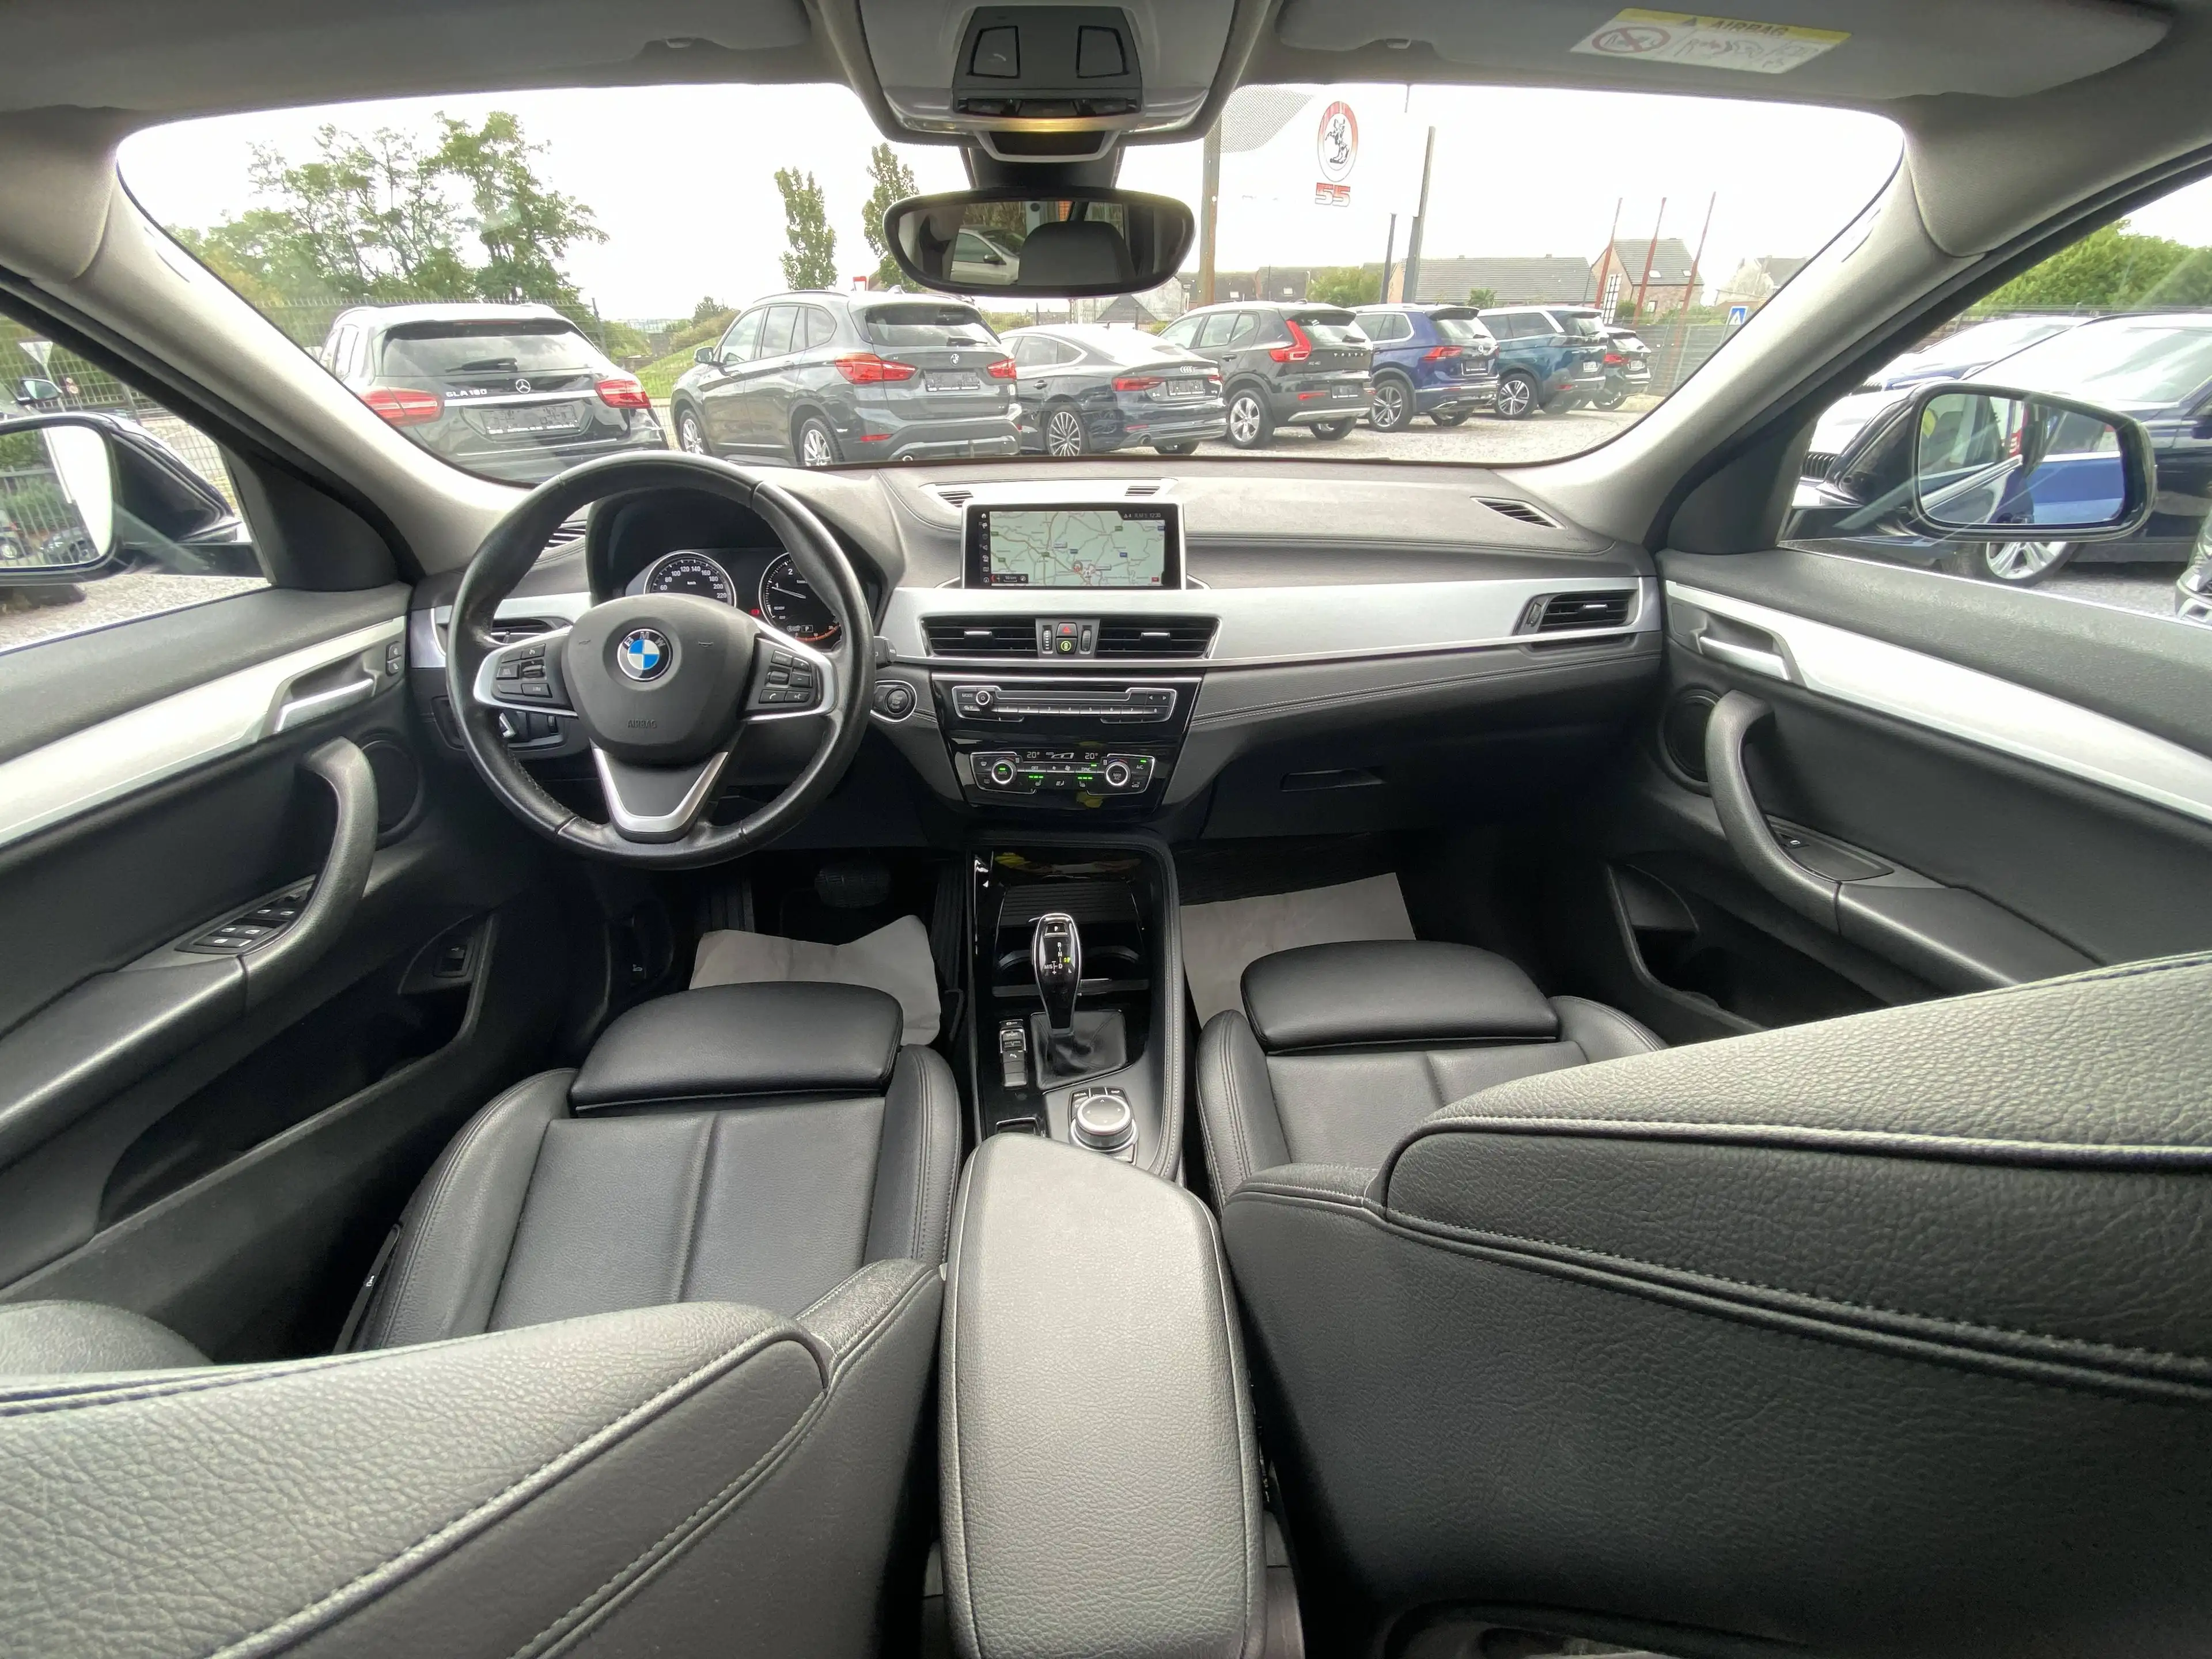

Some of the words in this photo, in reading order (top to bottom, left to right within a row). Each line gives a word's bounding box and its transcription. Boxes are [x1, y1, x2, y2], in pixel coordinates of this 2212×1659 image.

[1709, 20, 1788, 36] AIRBAG
[1315, 183, 1350, 207] 55
[624, 631, 666, 647] BMW
